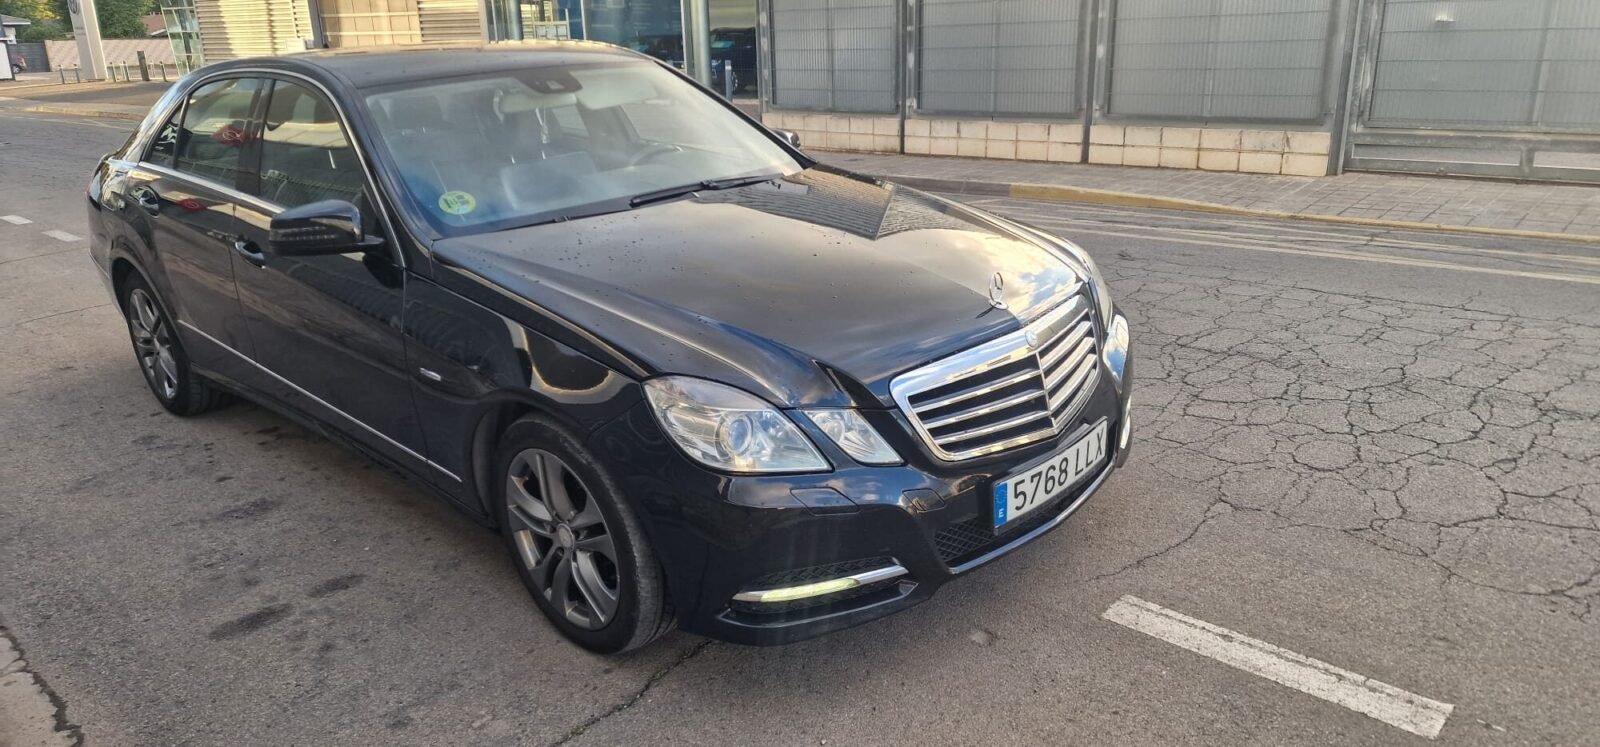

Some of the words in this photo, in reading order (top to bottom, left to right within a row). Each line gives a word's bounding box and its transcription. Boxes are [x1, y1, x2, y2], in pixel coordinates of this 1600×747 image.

[1014, 457, 1069, 511] 5768
[1074, 427, 1104, 477] LLX
[998, 508, 1004, 518] E
